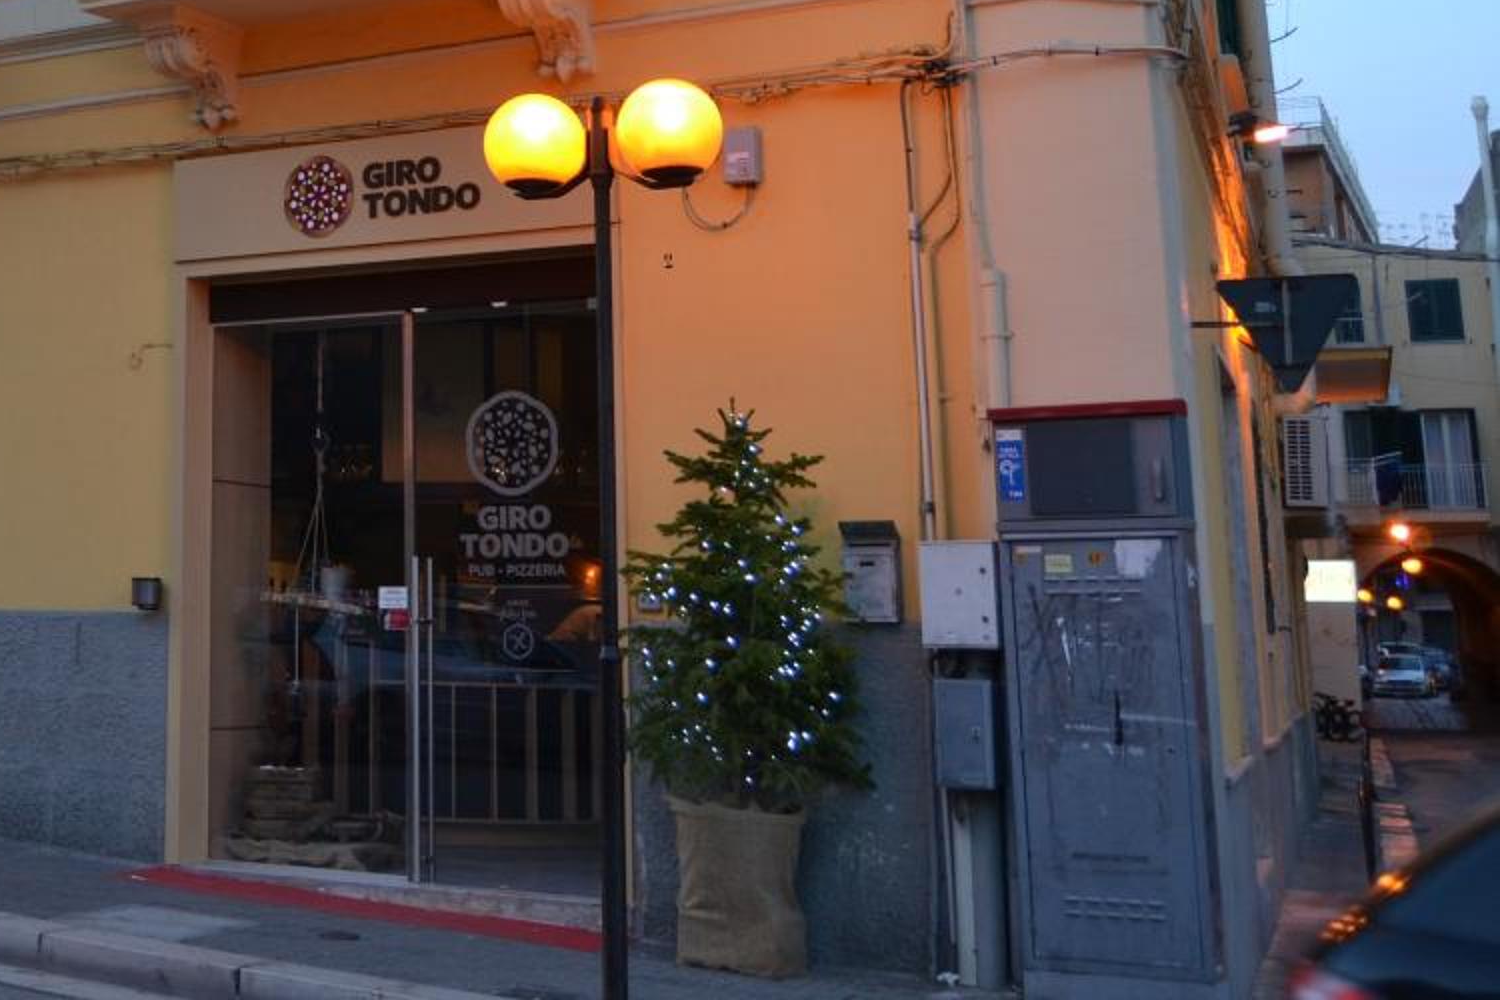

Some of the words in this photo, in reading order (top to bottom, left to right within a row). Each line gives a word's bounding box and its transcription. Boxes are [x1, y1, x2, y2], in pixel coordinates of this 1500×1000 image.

[362, 156, 441, 189] GIRO
[363, 183, 481, 219] TONDO
[477, 505, 551, 531] GIRO
[460, 533, 569, 559] TONDO
[468, 564, 495, 576] PUB
[506, 563, 565, 577] PIZZERIA
